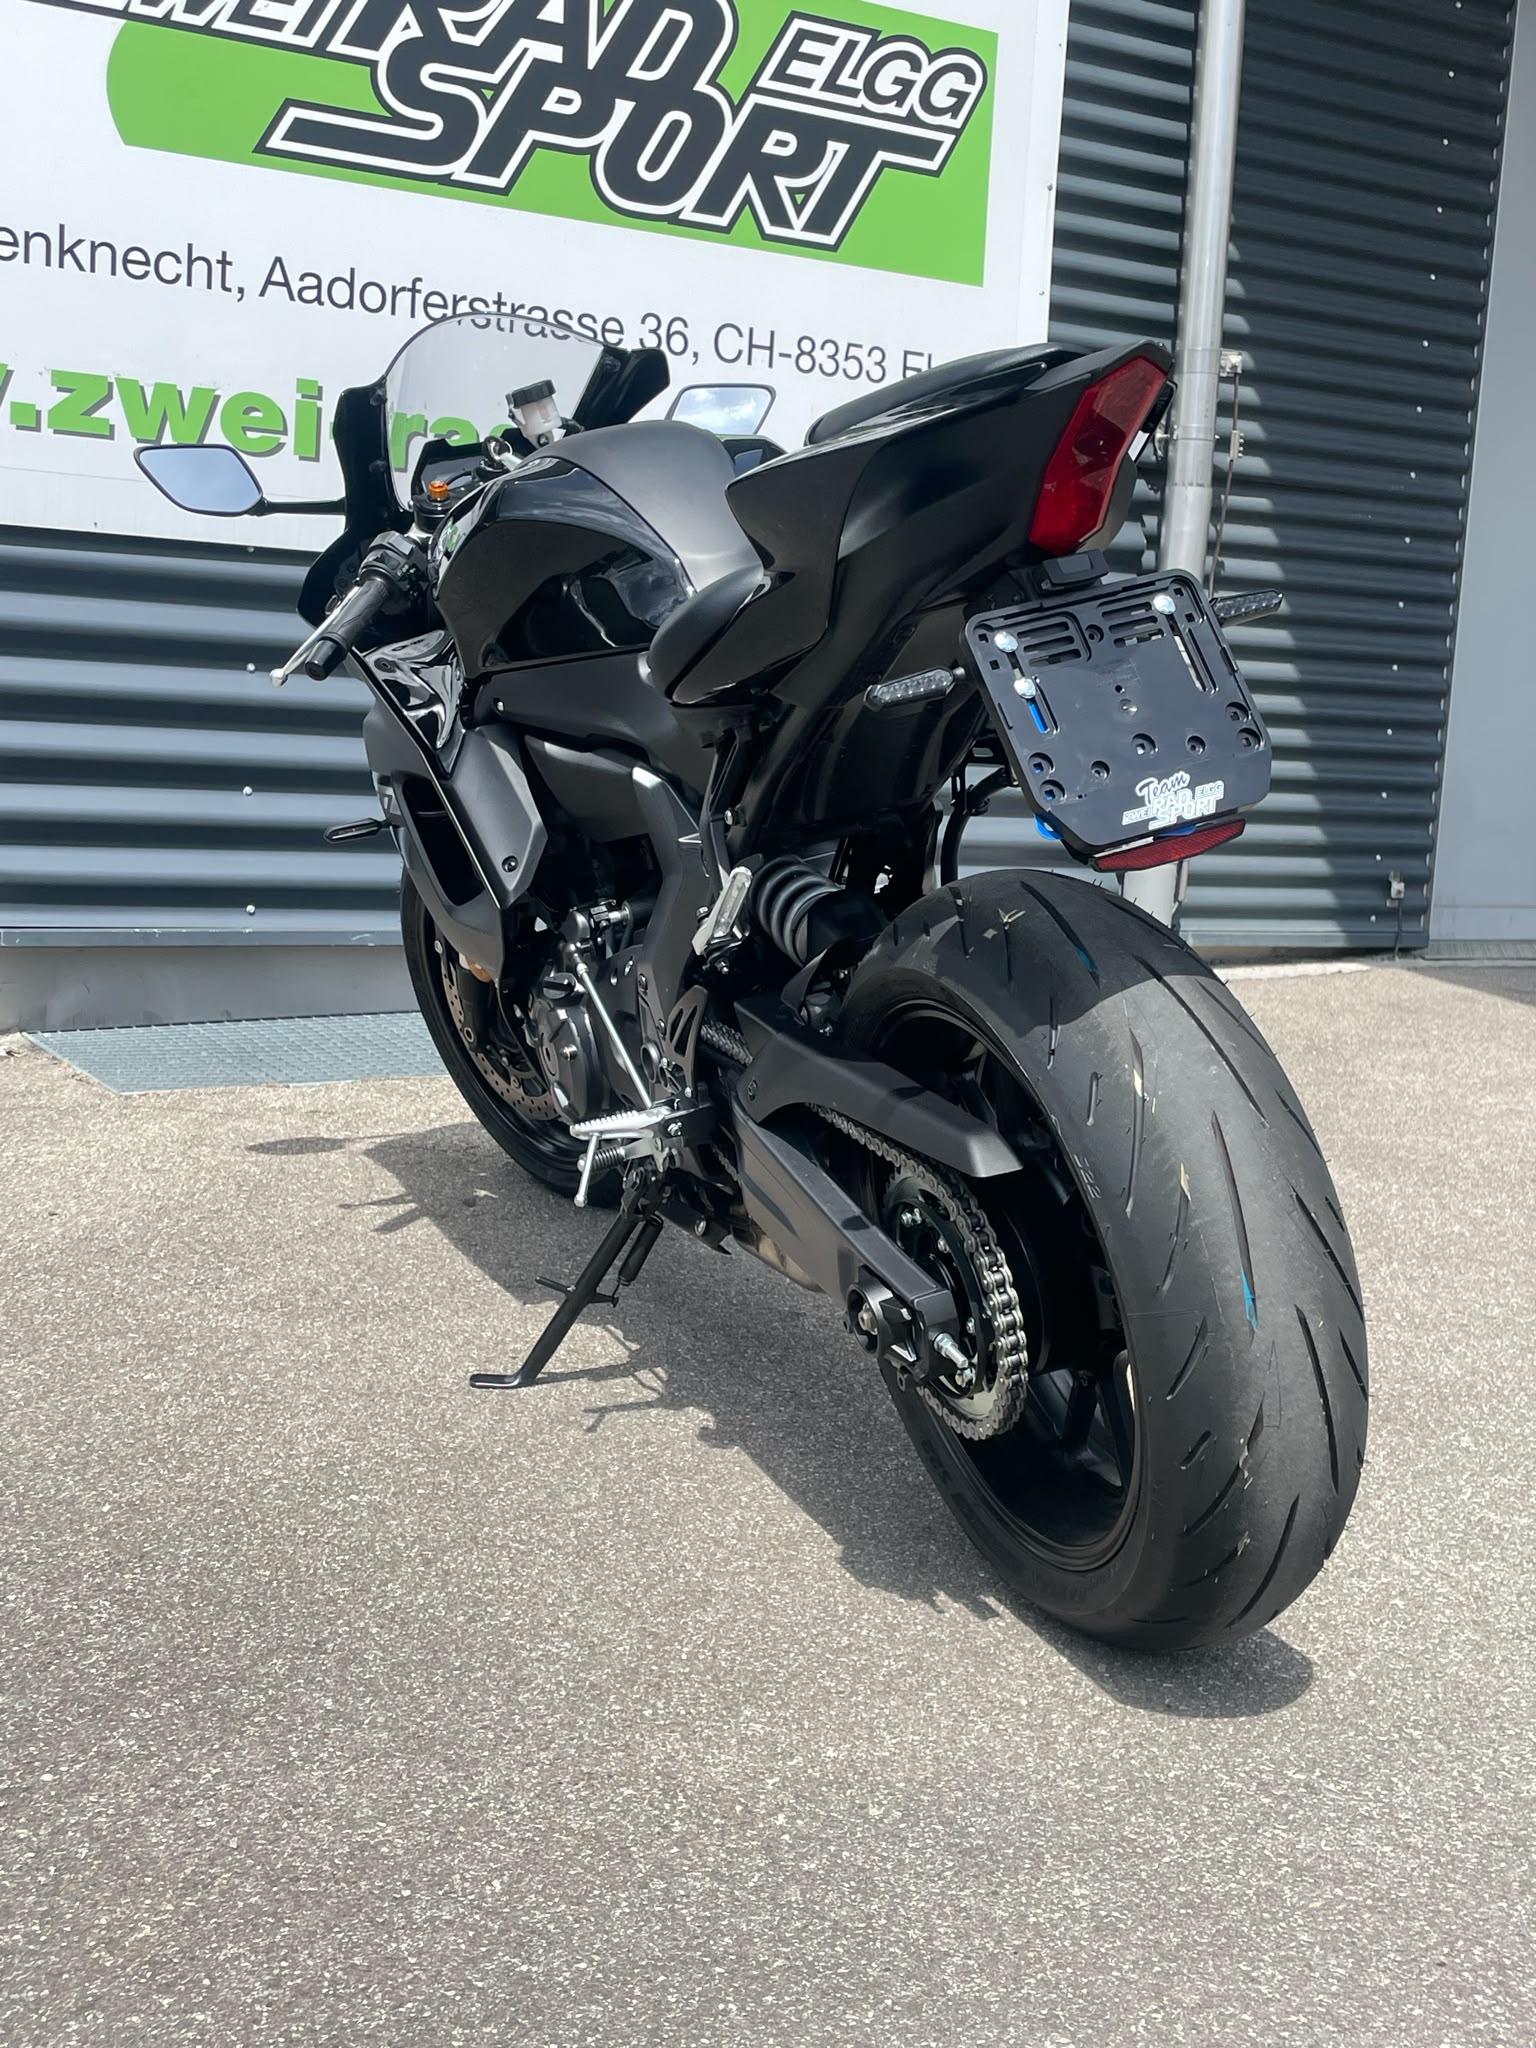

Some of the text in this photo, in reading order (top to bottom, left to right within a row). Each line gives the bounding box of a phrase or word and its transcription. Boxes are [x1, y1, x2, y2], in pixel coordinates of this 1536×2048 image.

[258, 36, 956, 249] SPORT
[753, 13, 986, 130] ELGG
[0, 223, 245, 302] enknecht,
[258, 256, 625, 347] Aadorferstrasse
[638, 312, 699, 366] 36,
[713, 322, 887, 384] CH-8353
